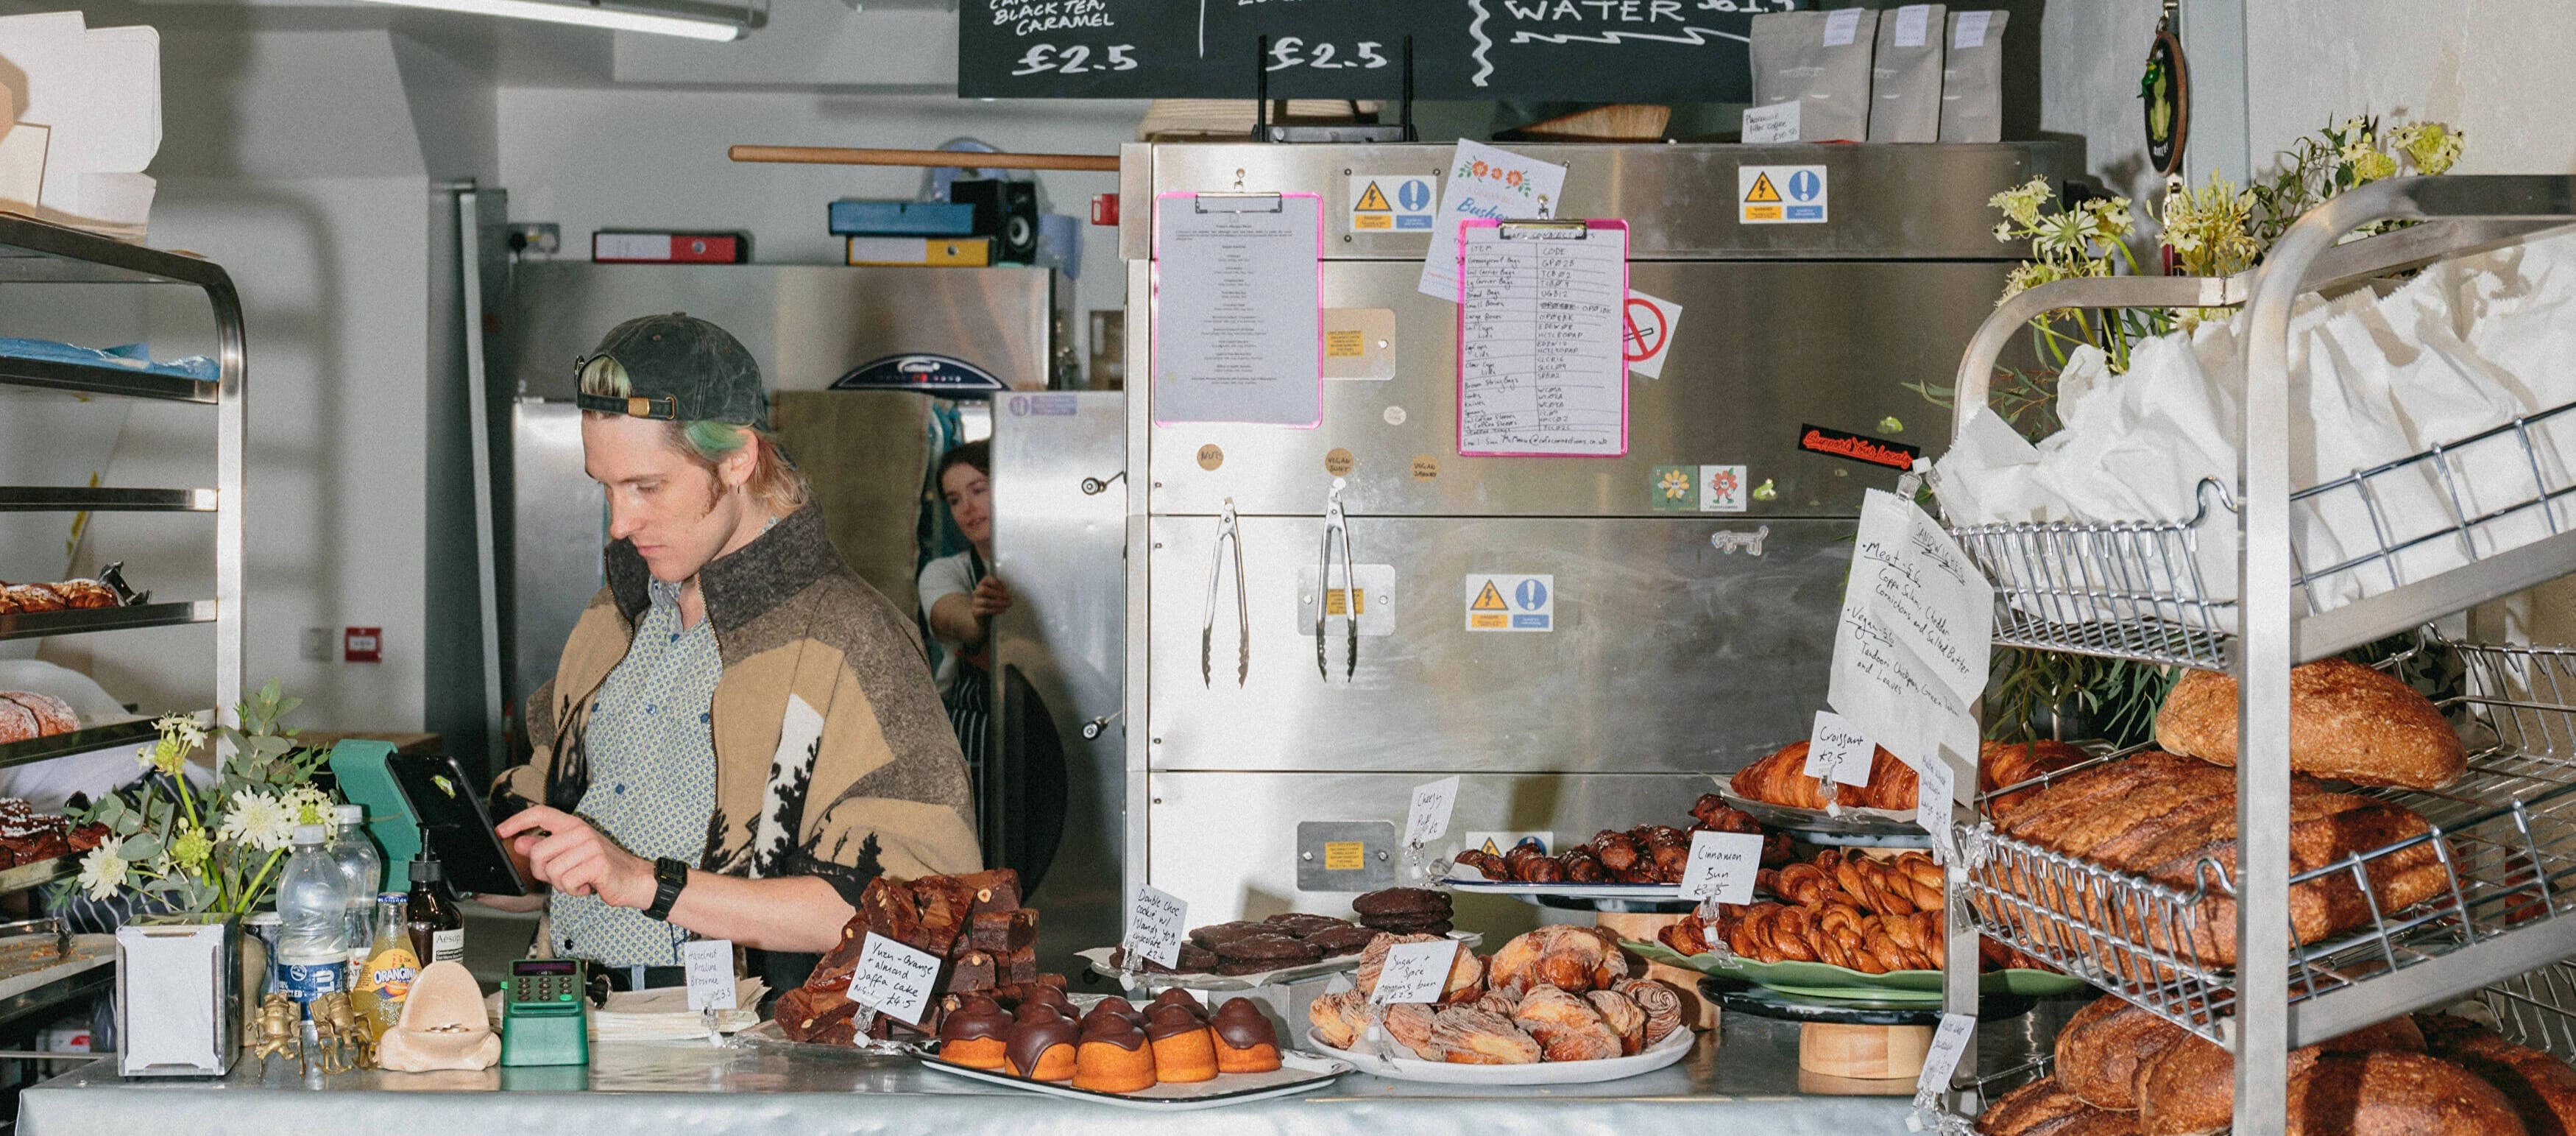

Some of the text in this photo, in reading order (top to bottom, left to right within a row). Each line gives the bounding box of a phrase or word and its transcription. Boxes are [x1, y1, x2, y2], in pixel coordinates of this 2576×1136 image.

[994, 1, 1058, 26] BLACK
[1504, 0, 1685, 22] WATER
[1016, 13, 1114, 36] CARAMEL
[1011, 43, 1139, 76] £2.5
[1265, 37, 1388, 71] £2.5
[1866, 542, 1900, 563] Meat
[1852, 606, 1878, 640] Vegan
[1876, 670, 1903, 696] Leaves
[1820, 726, 1864, 748] Croissant
[1697, 844, 1742, 861] Cinnamon
[1138, 888, 1180, 917] Double Choc
[436, 935, 461, 943] Aesop
[874, 960, 910, 980] almond
[1390, 954, 1418, 971] Sugar
[1403, 964, 1425, 980] Spice
[858, 968, 919, 998] Jaffa cake
